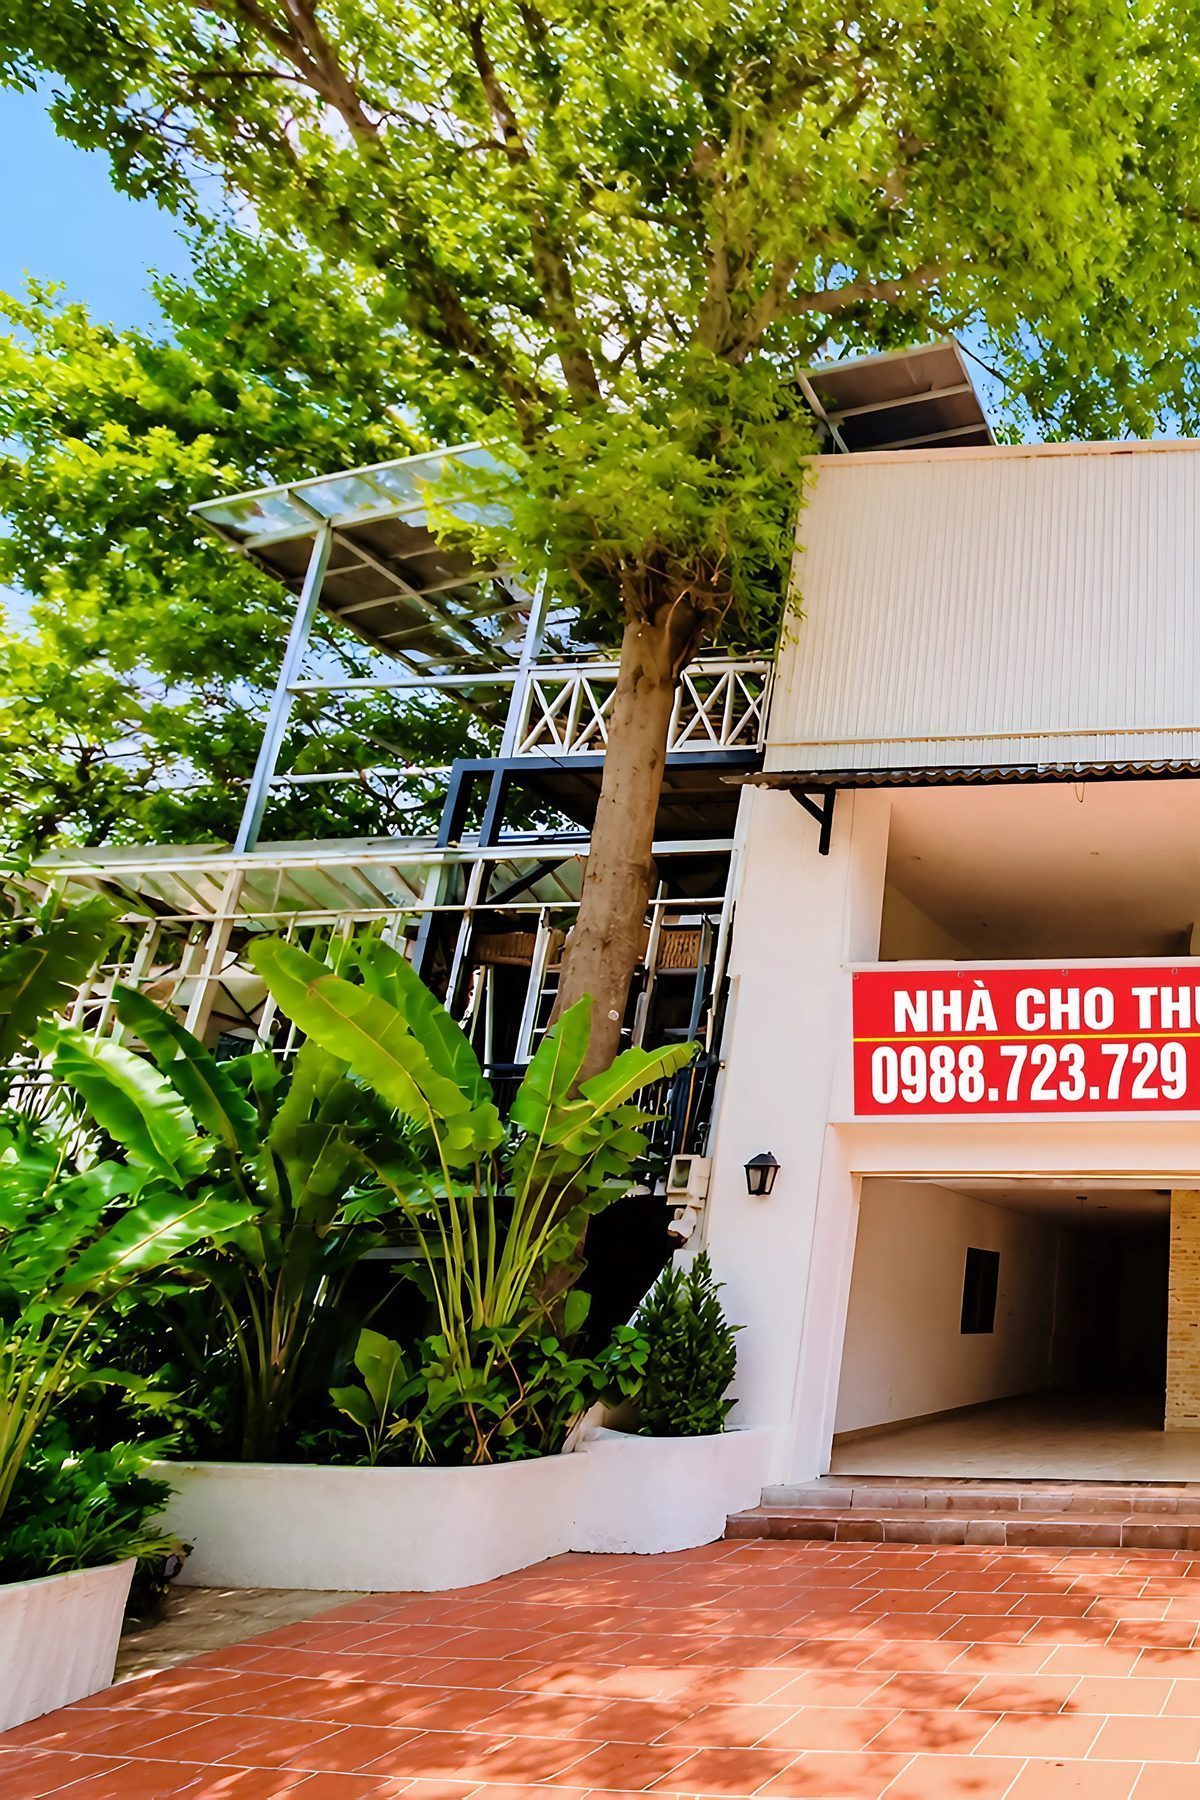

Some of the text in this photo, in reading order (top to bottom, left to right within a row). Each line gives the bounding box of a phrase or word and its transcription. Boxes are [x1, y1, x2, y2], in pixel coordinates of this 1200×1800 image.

[893, 979, 999, 1033] NHÀ
[1015, 986, 1114, 1032] CHO
[871, 1041, 1188, 1104] 0988.723.729
